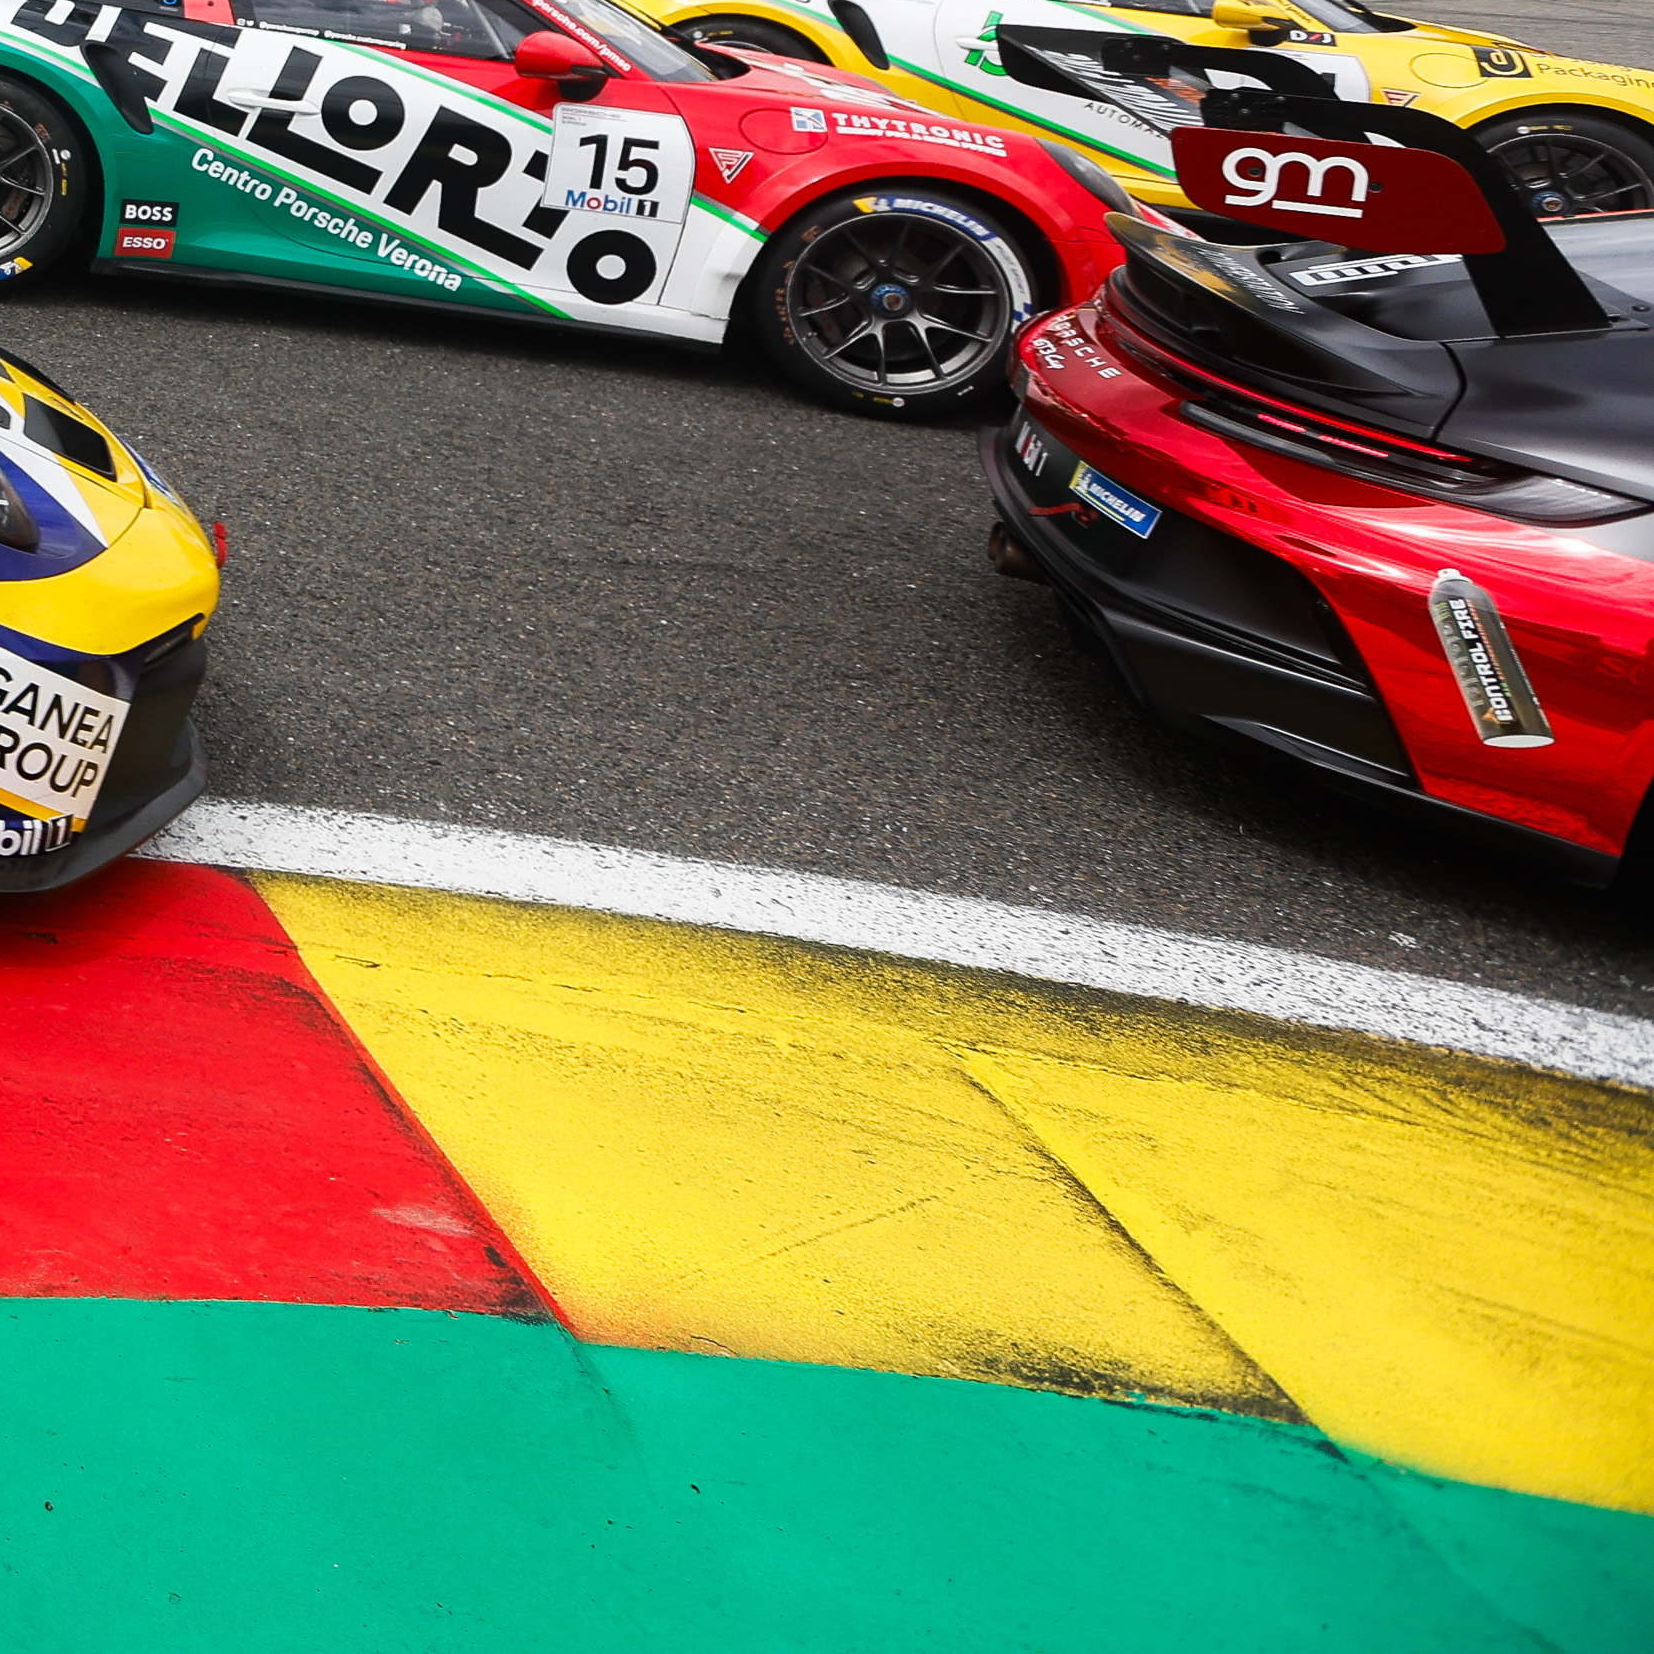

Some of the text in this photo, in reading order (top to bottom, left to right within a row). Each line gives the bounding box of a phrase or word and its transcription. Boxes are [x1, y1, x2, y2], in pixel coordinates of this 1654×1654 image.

[832, 112, 1007, 149] THYTRONIC
[579, 133, 660, 195] 15
[1222, 147, 1369, 218] gm
[125, 203, 173, 223] BOSS
[192, 148, 463, 292] Centro Porsche Verona
[565, 189, 632, 215] Mobil
[892, 198, 990, 236] MICHELIN
[122, 235, 167, 251] ESSO
[1089, 484, 1147, 523] MICHELIN
[1448, 598, 1479, 639] FIRE
